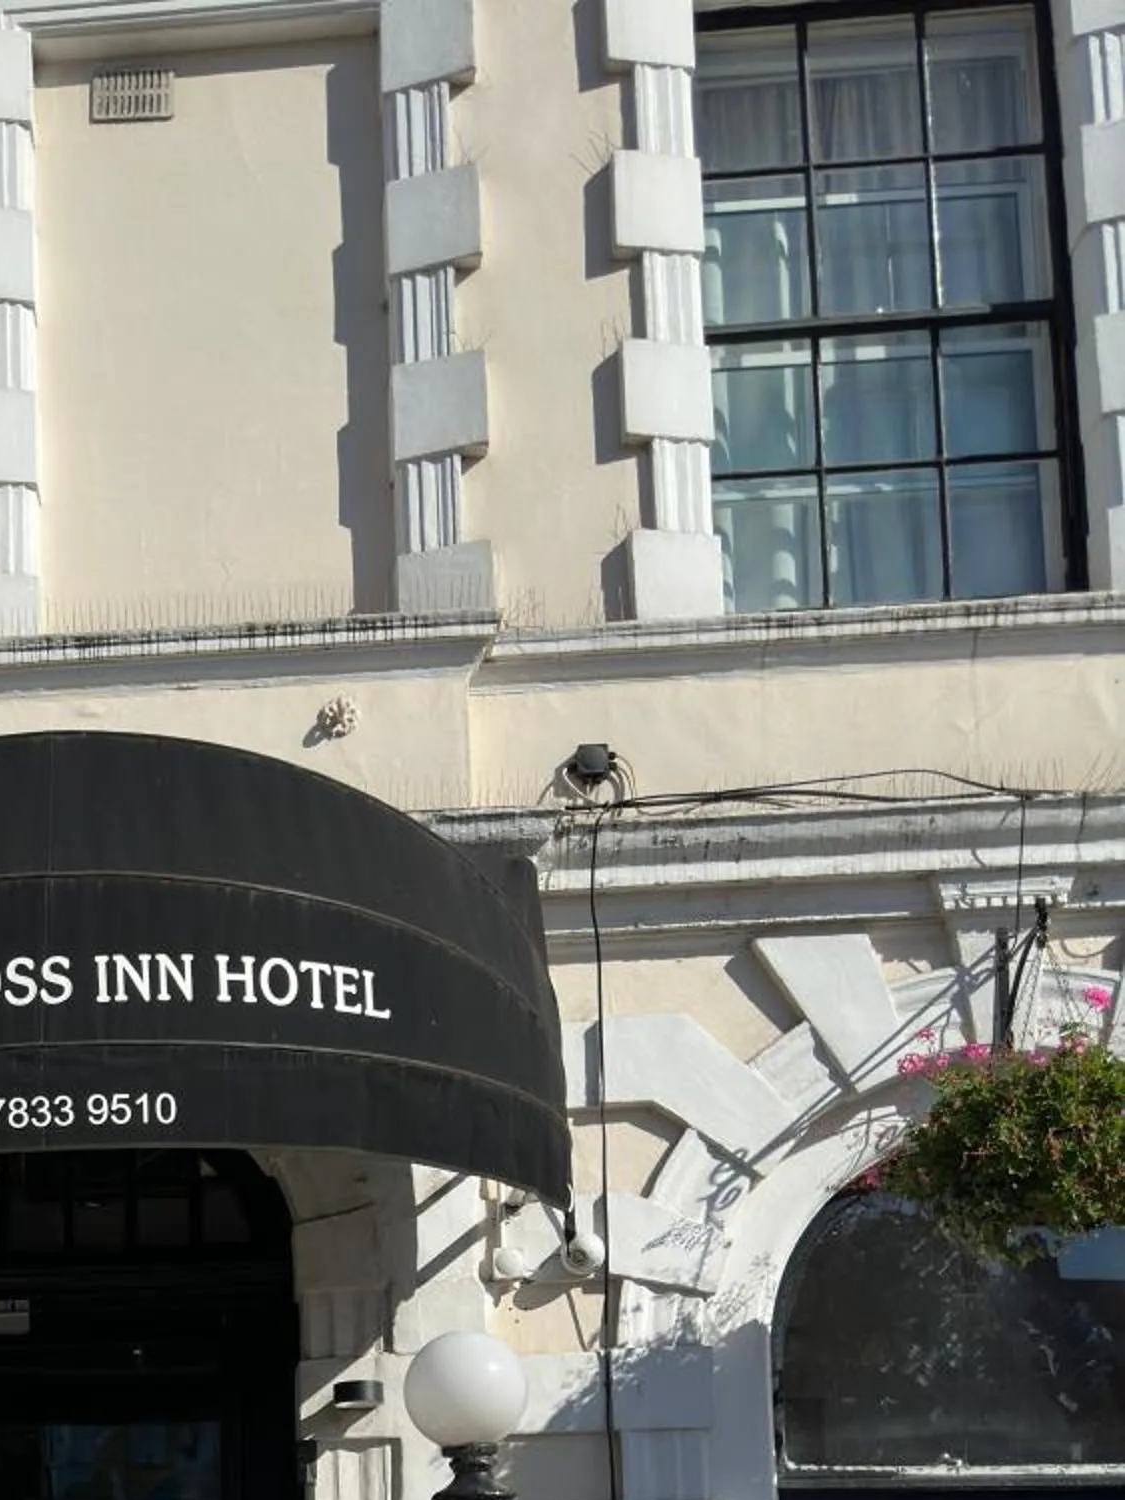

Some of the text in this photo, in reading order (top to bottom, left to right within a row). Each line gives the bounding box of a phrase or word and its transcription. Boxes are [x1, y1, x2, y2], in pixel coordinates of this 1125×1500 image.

[94, 953, 195, 1003] INN
[214, 953, 392, 1020] HOTEL
[86, 1092, 178, 1126] 9510
